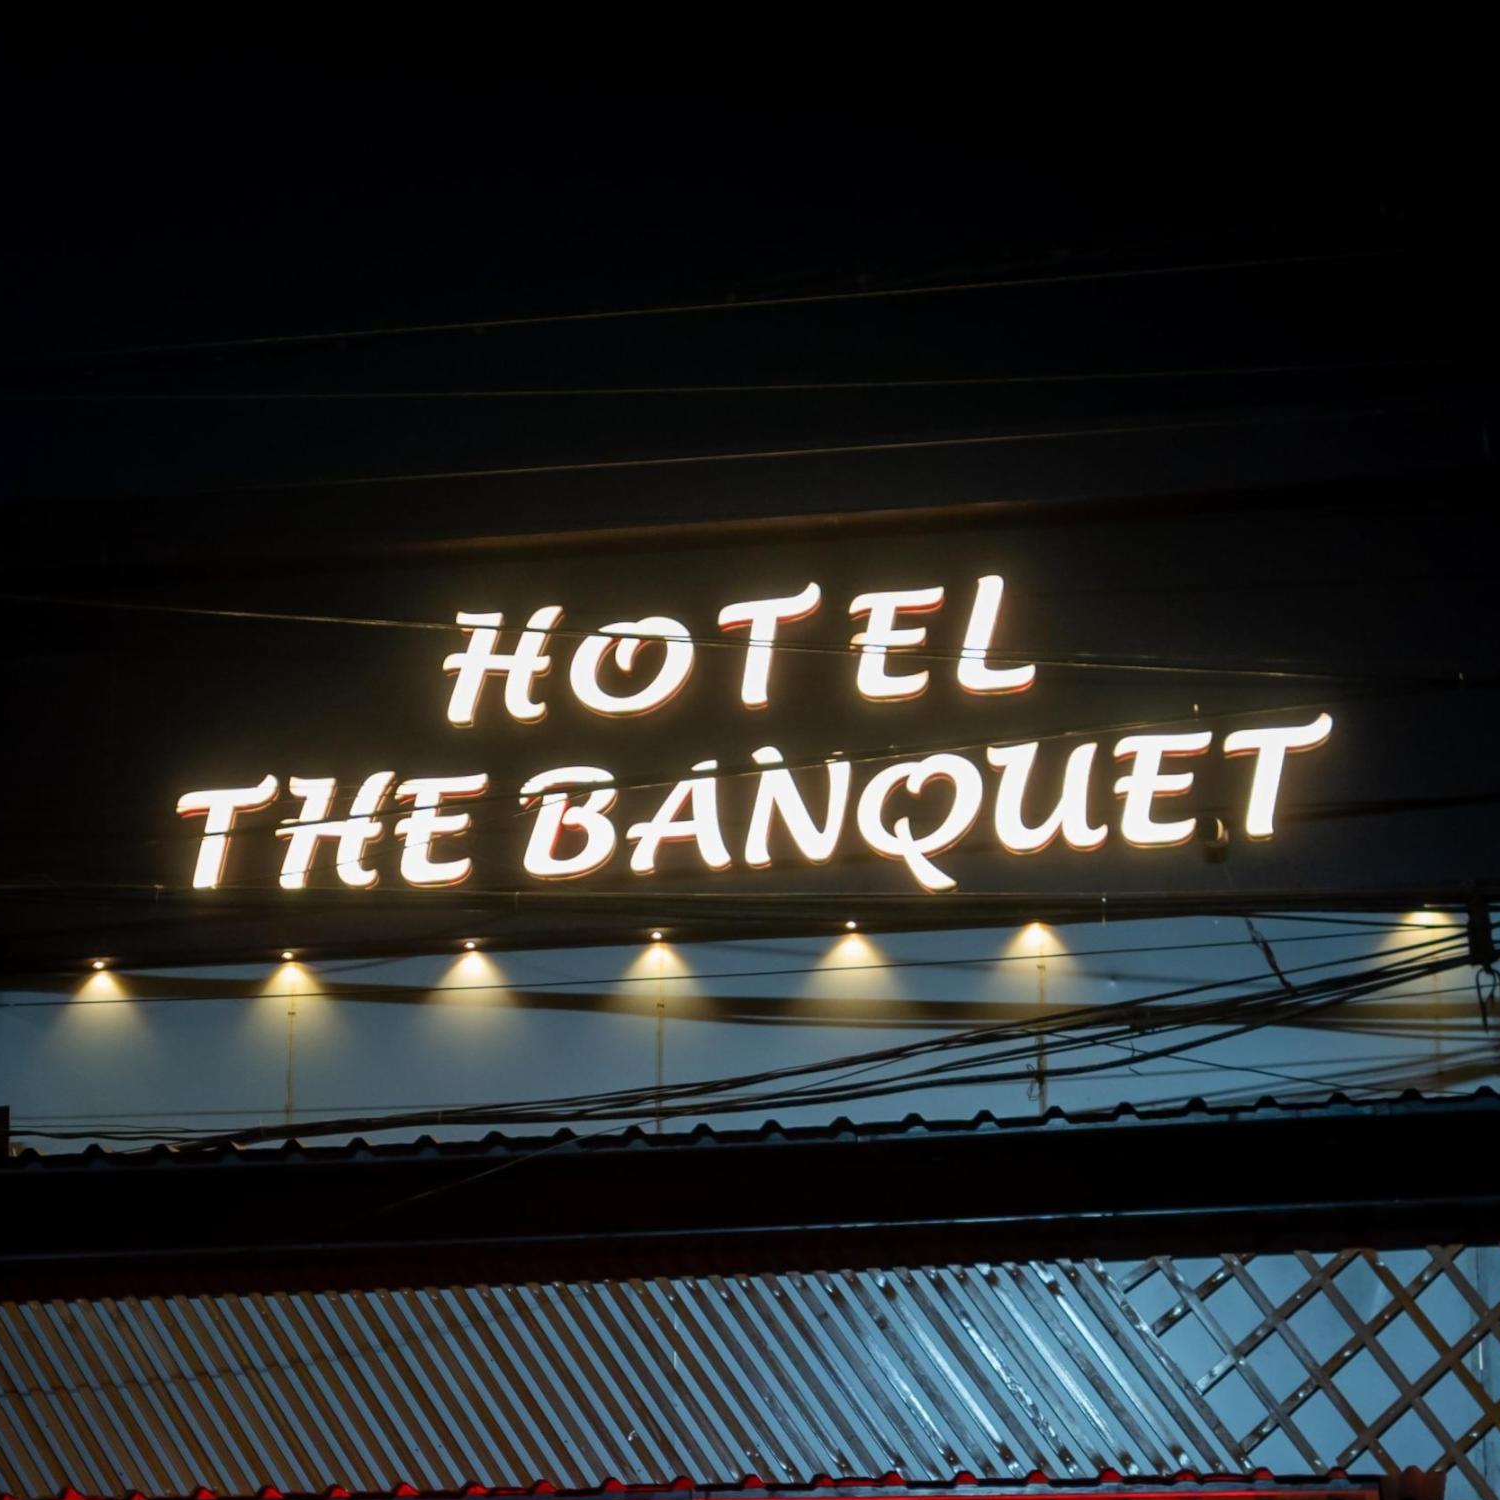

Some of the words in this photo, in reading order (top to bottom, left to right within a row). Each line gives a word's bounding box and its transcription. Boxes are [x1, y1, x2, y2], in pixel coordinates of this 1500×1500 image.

[443, 574, 1036, 727] HOTEL
[177, 769, 489, 890] THE
[519, 712, 1332, 893] BANQUET
